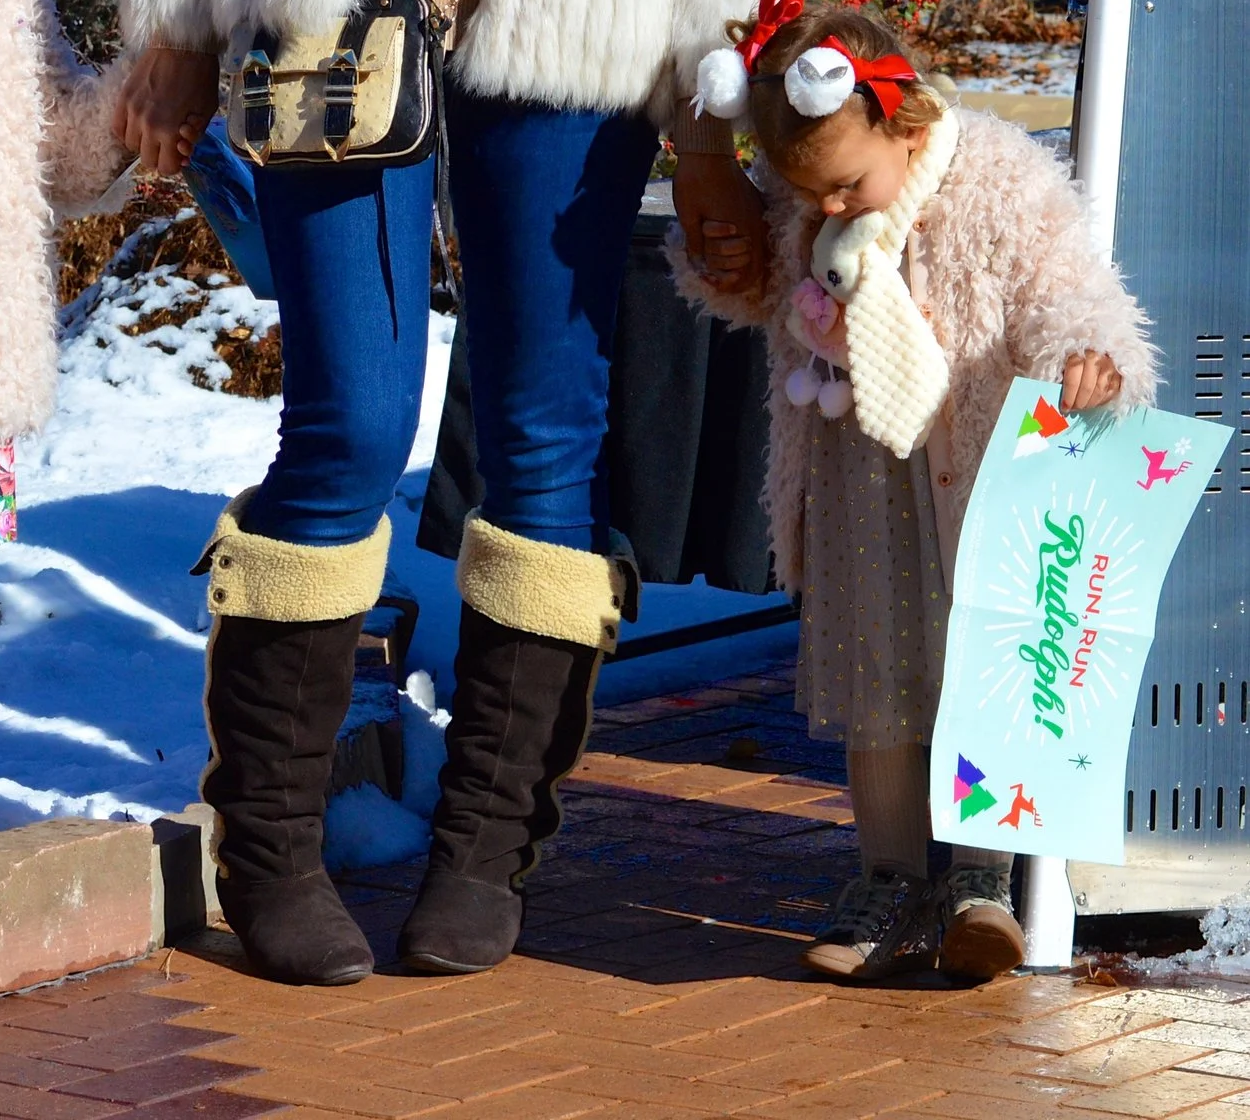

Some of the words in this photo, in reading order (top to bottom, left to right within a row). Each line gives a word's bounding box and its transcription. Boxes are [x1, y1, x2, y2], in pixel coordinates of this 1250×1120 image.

[1081, 554, 1110, 620] RUN,
[1018, 510, 1085, 740] Rudolph!
[1070, 629, 1098, 687] RUN
